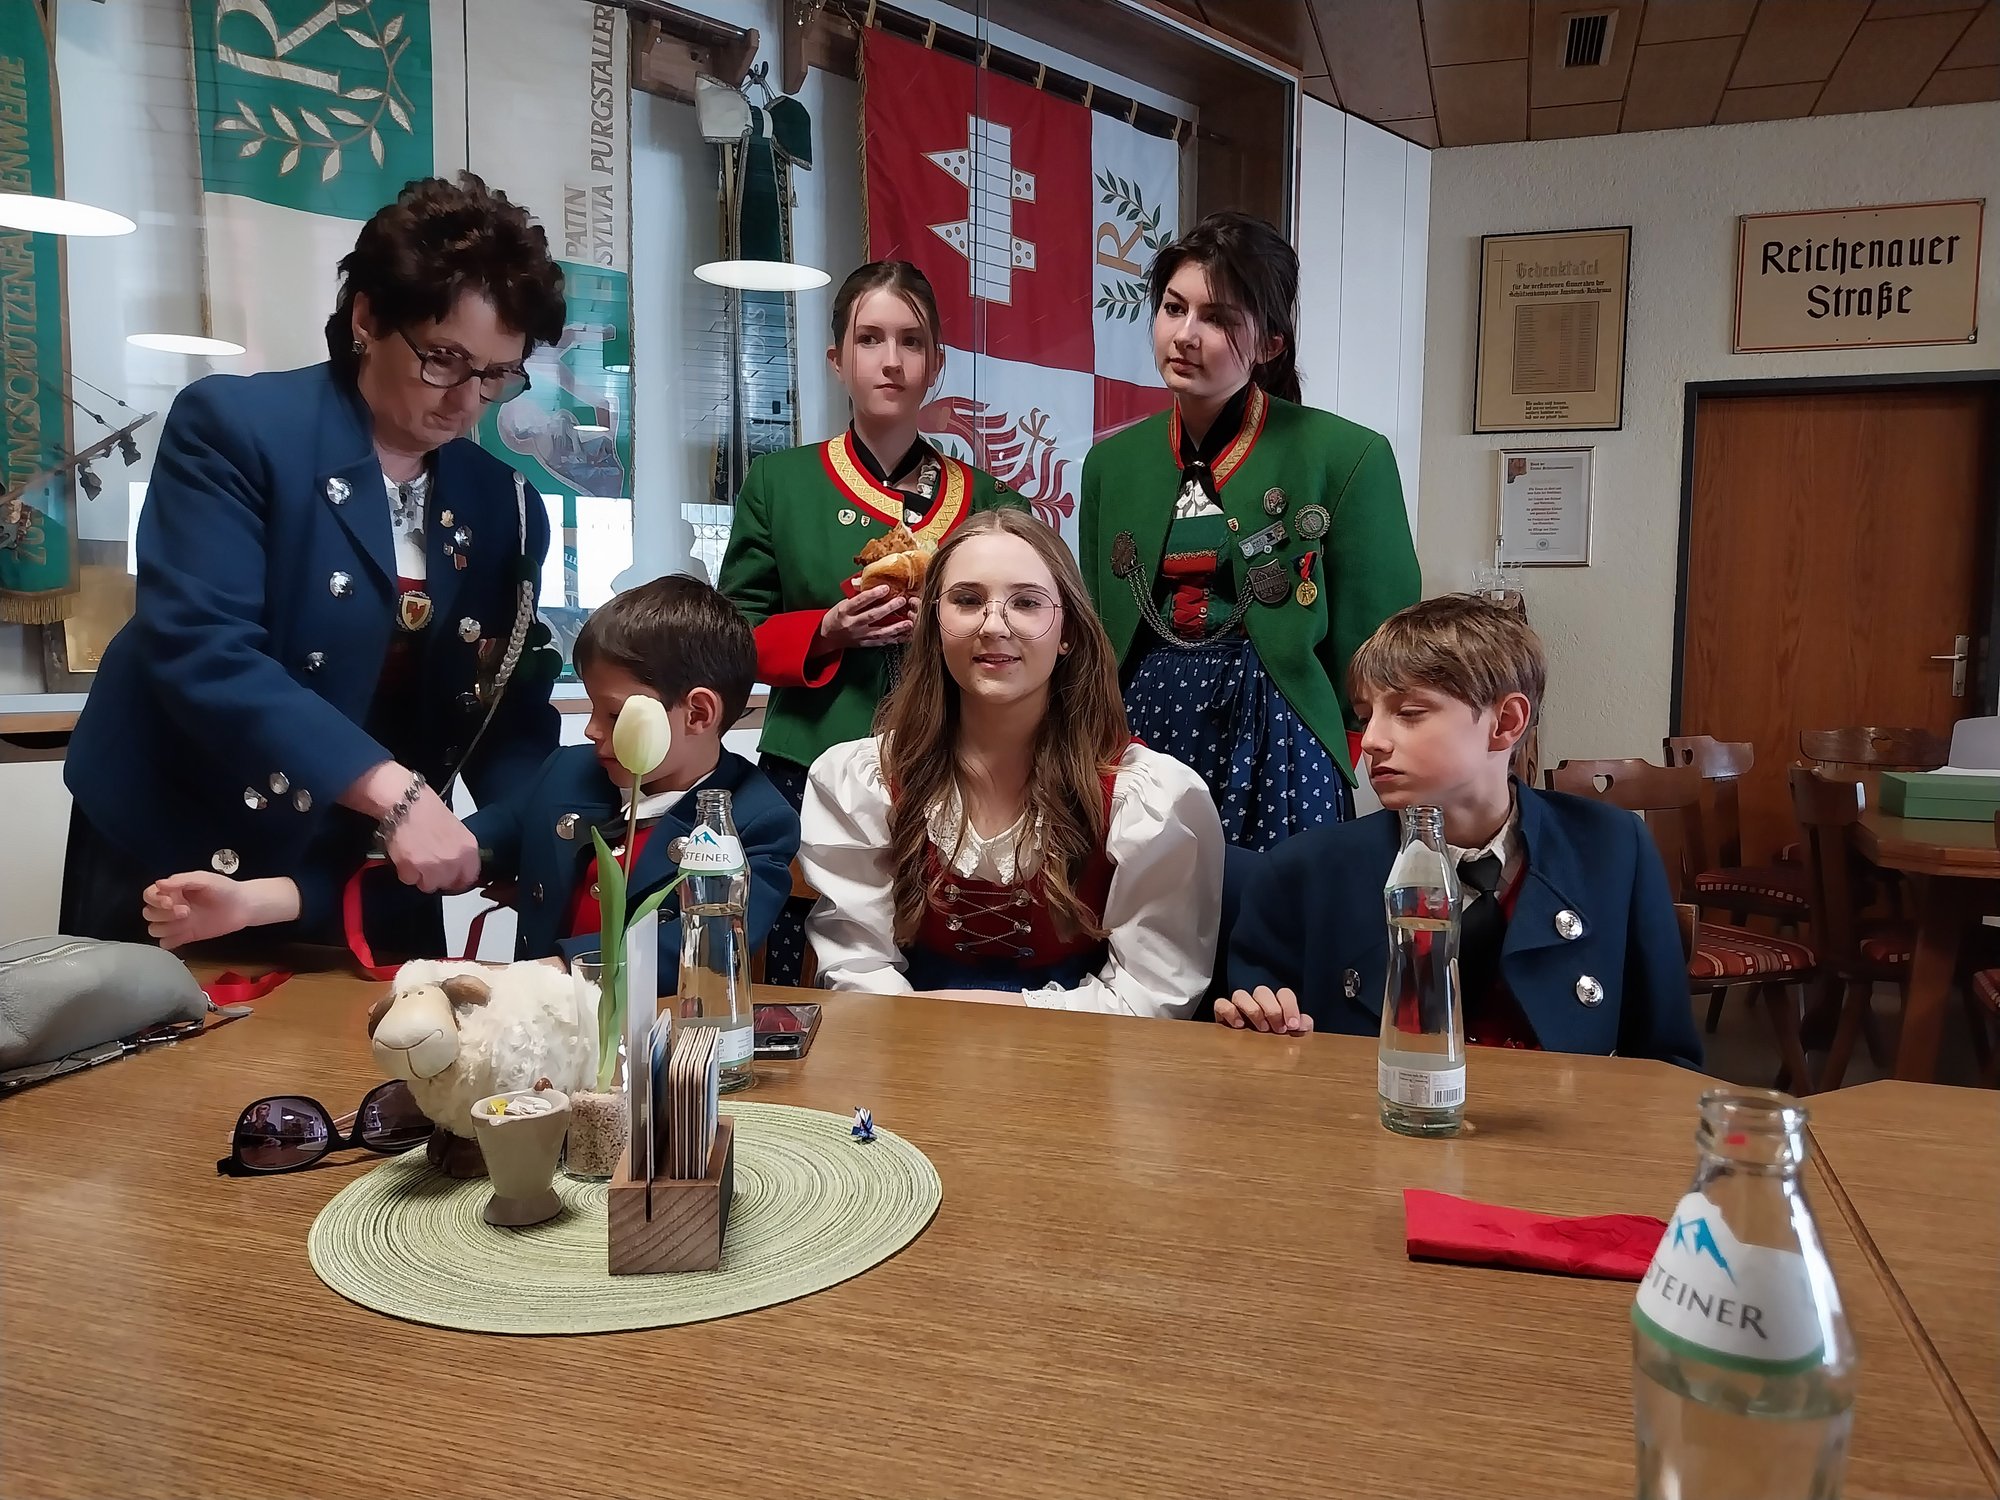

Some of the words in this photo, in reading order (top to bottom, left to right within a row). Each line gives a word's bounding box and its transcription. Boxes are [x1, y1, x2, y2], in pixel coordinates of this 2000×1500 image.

[590, 4, 615, 176] PURGSTALLER
[564, 184, 588, 257] PATIN
[591, 184, 613, 267] SYLVIA
[1096, 219, 1143, 277] R
[1761, 235, 1960, 275] Reichenauer
[1807, 281, 1912, 320] Straße
[684, 851, 731, 864] STEINER
